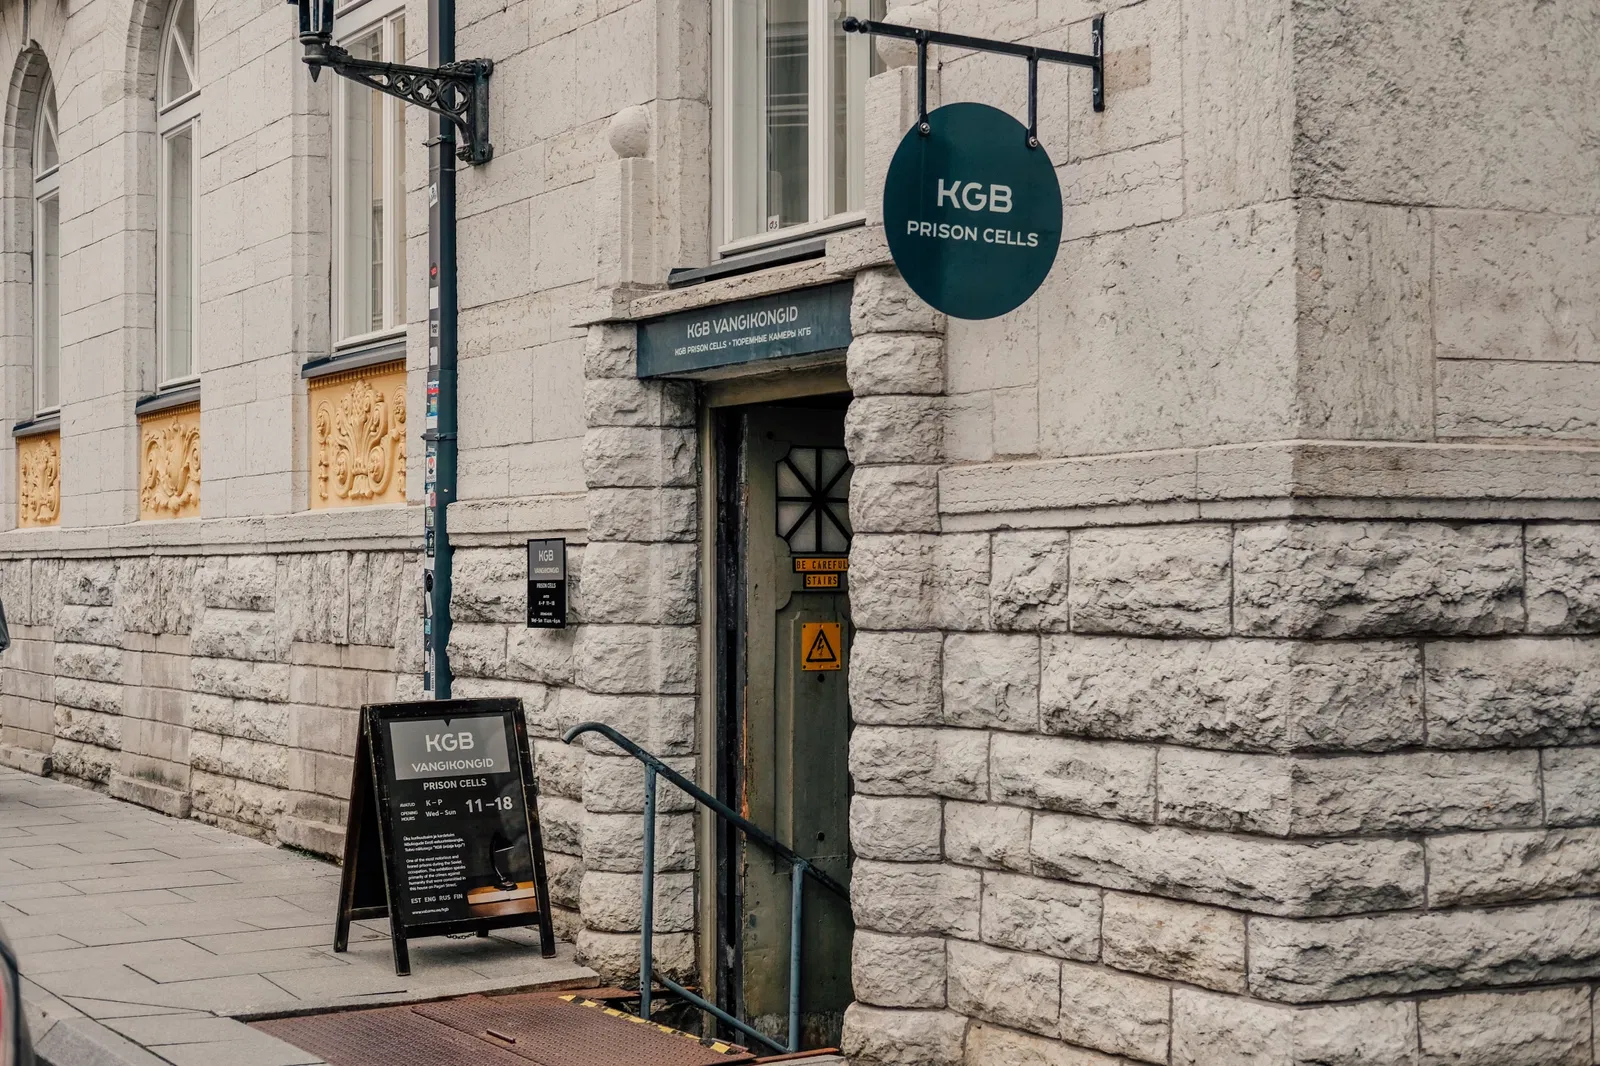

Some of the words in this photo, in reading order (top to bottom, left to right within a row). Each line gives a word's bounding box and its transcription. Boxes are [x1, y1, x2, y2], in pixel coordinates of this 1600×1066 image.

[937, 178, 1012, 213] KGB
[907, 220, 978, 241] PRISON
[983, 228, 1038, 247] CELLS
[687, 321, 710, 338] KGB
[713, 306, 798, 334] VANGIKONGID
[732, 334, 767, 347] ТЮРЕМНЫЕ
[768, 330, 796, 341] КАМЕРЫ
[798, 326, 812, 336] КГБ
[674, 348, 686, 356] KGB
[687, 344, 708, 354] PRISON
[709, 340, 727, 350] CELLS
[538, 550, 554, 561] KGB
[796, 560, 806, 569] BE
[812, 560, 848, 570] CAREFUL
[807, 576, 837, 585] STAIRS
[425, 732, 475, 752] KGB
[411, 758, 494, 772] VANGIKONGID
[423, 780, 457, 790] PRISON
[460, 778, 487, 788] CELLS
